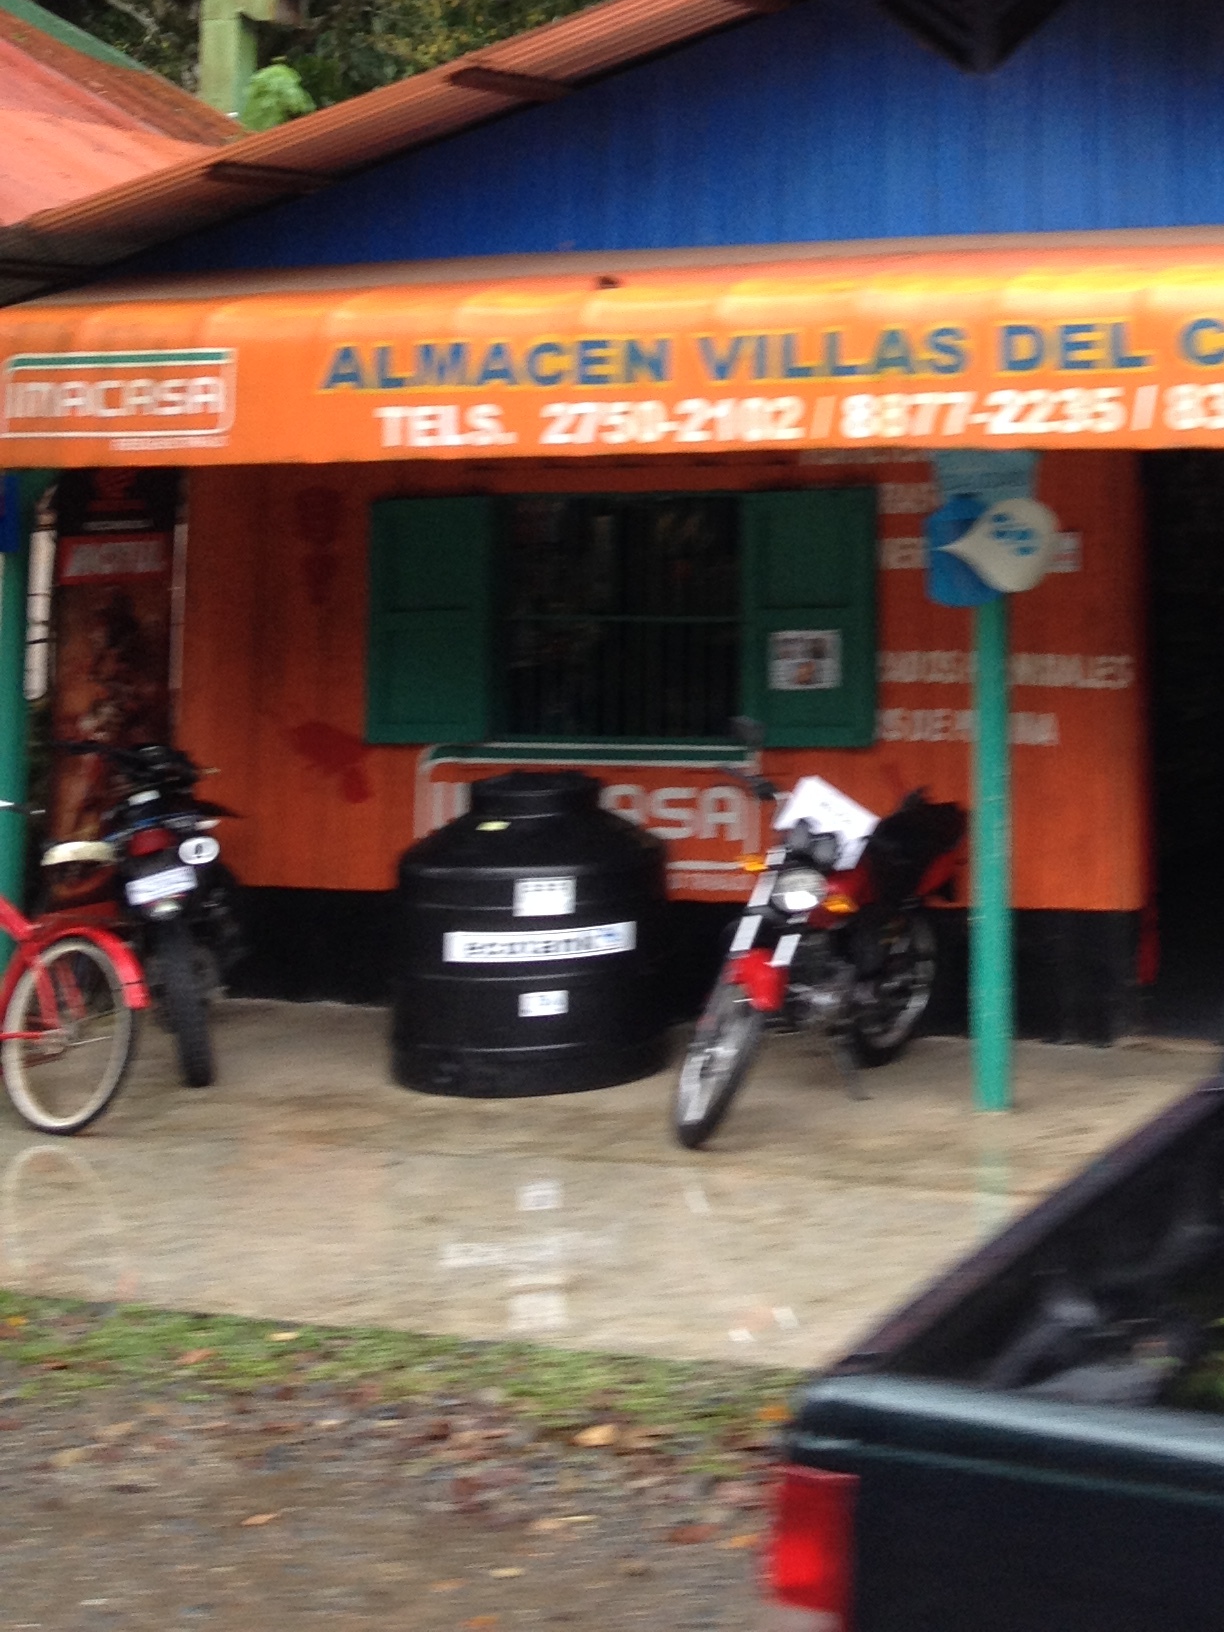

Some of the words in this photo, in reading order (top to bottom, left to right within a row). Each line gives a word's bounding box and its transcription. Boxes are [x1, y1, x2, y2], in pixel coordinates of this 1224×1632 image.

[321, 334, 671, 391] ALMACEN
[697, 325, 969, 380] VILLAS
[1001, 319, 1153, 371] DEL
[372, 403, 518, 447] TELS.
[539, 396, 806, 445] 2750-2102
